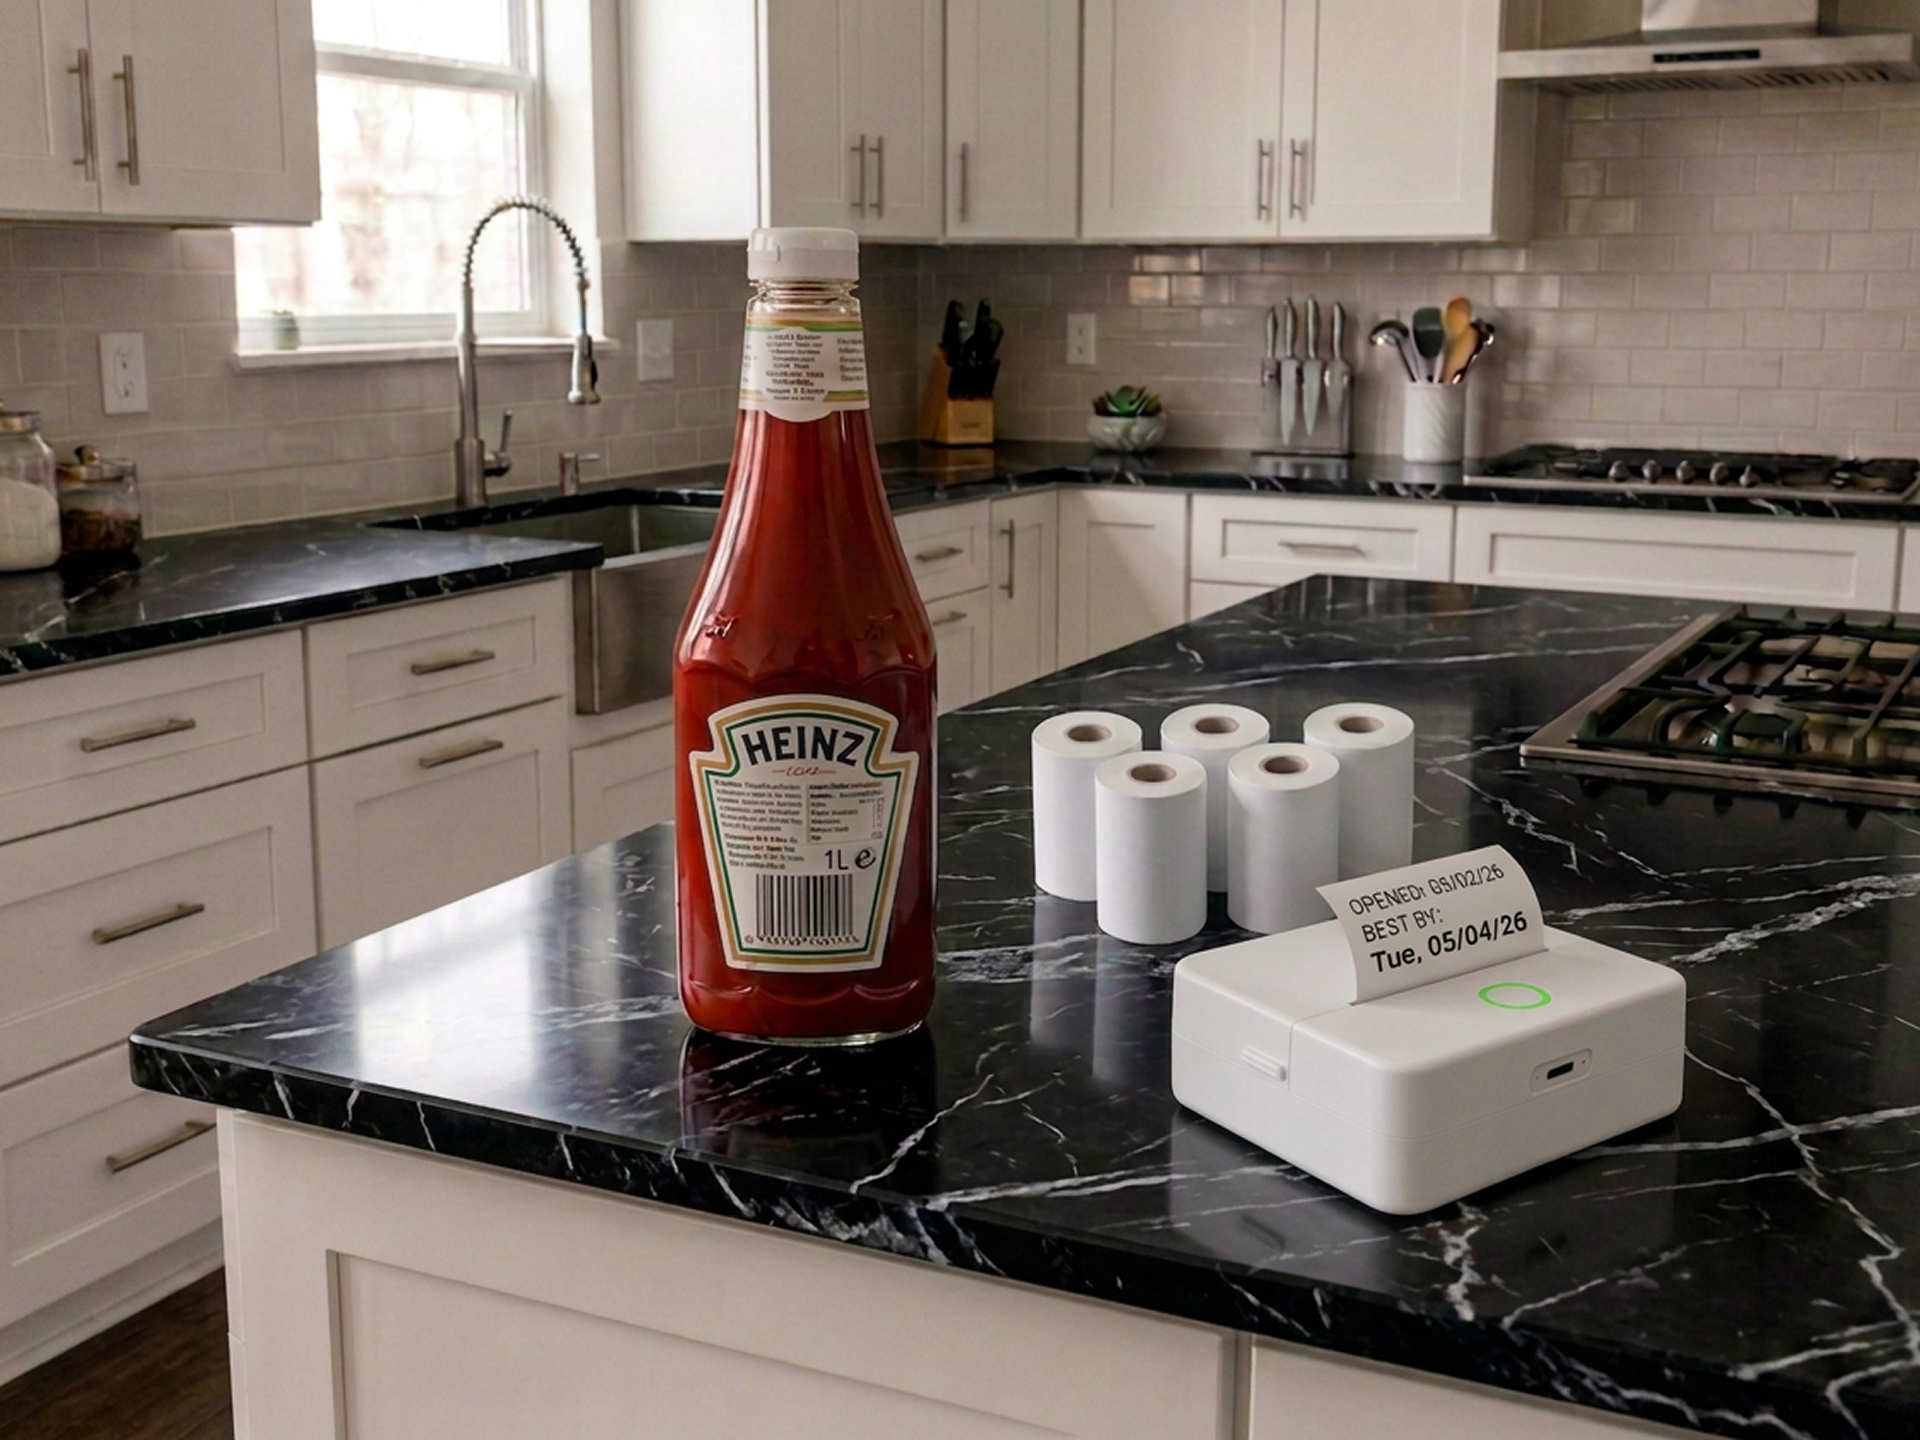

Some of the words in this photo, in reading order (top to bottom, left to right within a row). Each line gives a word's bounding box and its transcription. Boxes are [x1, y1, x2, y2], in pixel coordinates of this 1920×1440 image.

[741, 726, 865, 766] HEINZ
[825, 849, 848, 870] 1L
[1349, 884, 1427, 915] OPENED:
[1362, 915, 1408, 943] BEST
[1413, 907, 1443, 929] BY:
[1370, 947, 1422, 972] Tue,
[1427, 911, 1527, 956] 05/04/26
